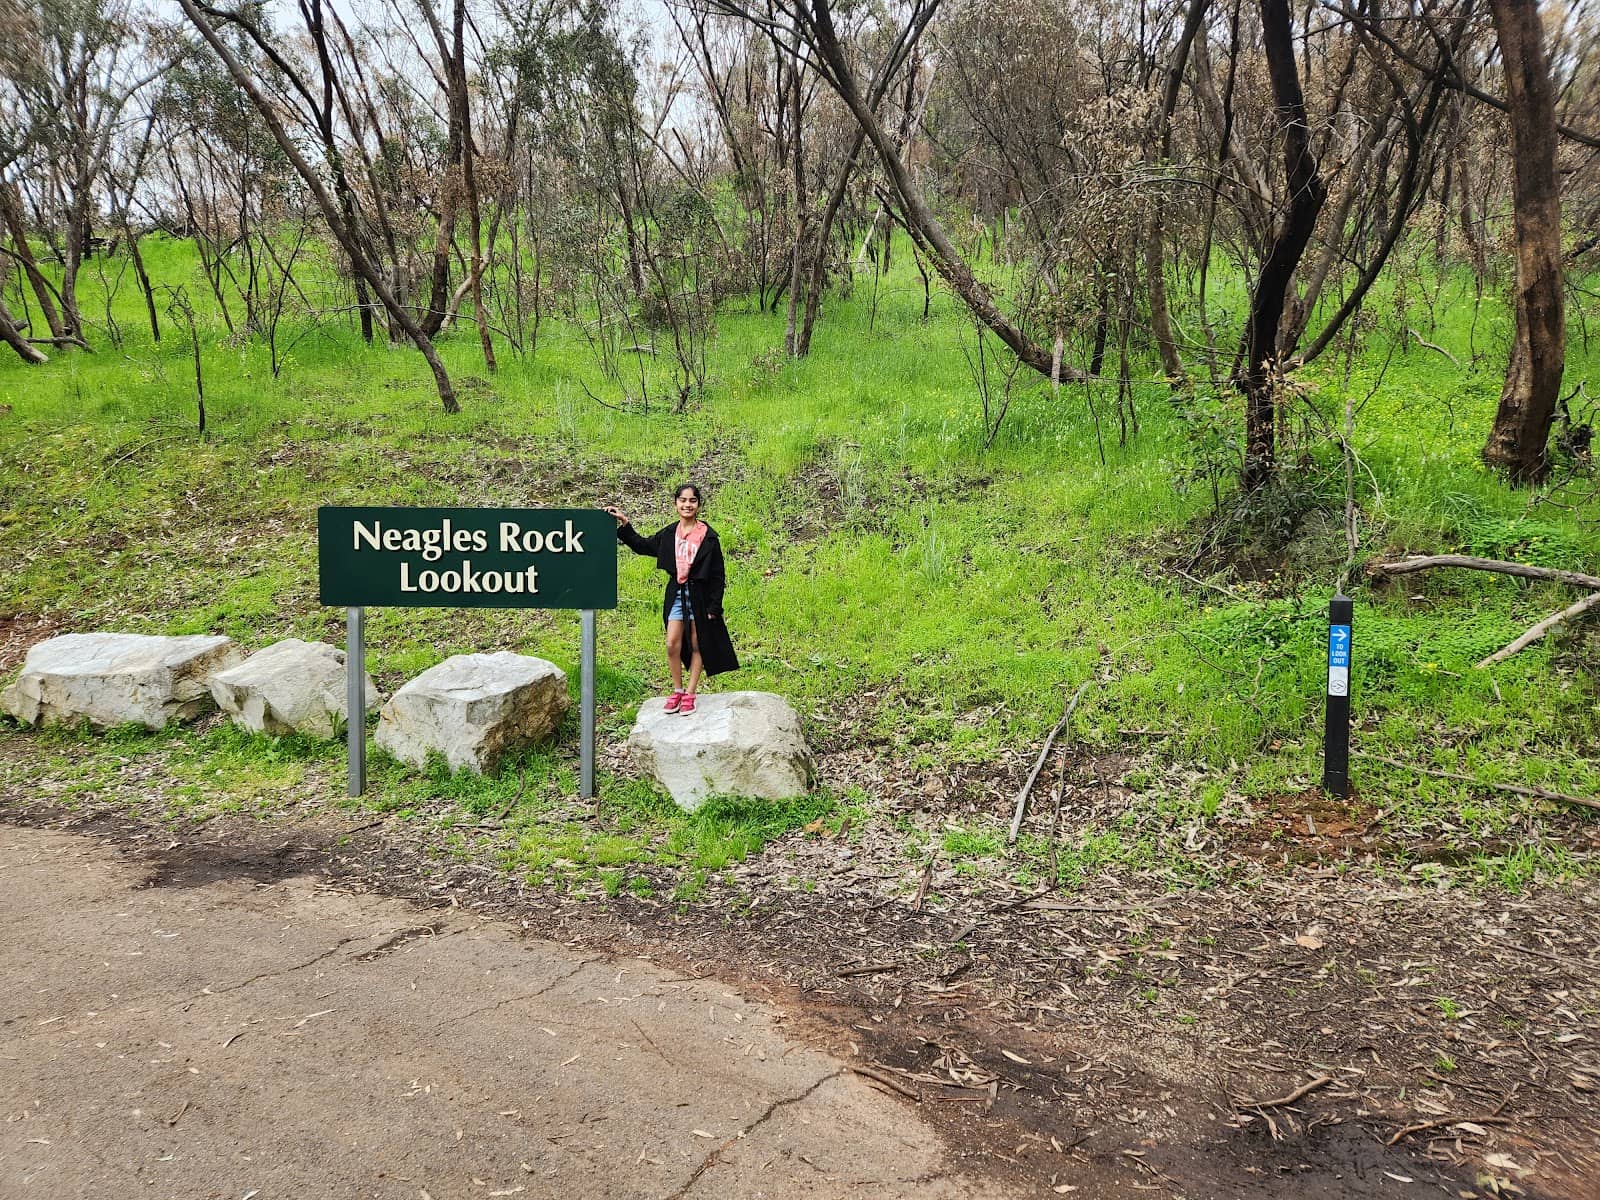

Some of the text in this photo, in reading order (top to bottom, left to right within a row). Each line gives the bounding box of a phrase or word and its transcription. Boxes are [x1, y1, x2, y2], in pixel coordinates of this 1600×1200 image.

[353, 518, 585, 561] Neagles Rock
[400, 560, 538, 593] Lookout
